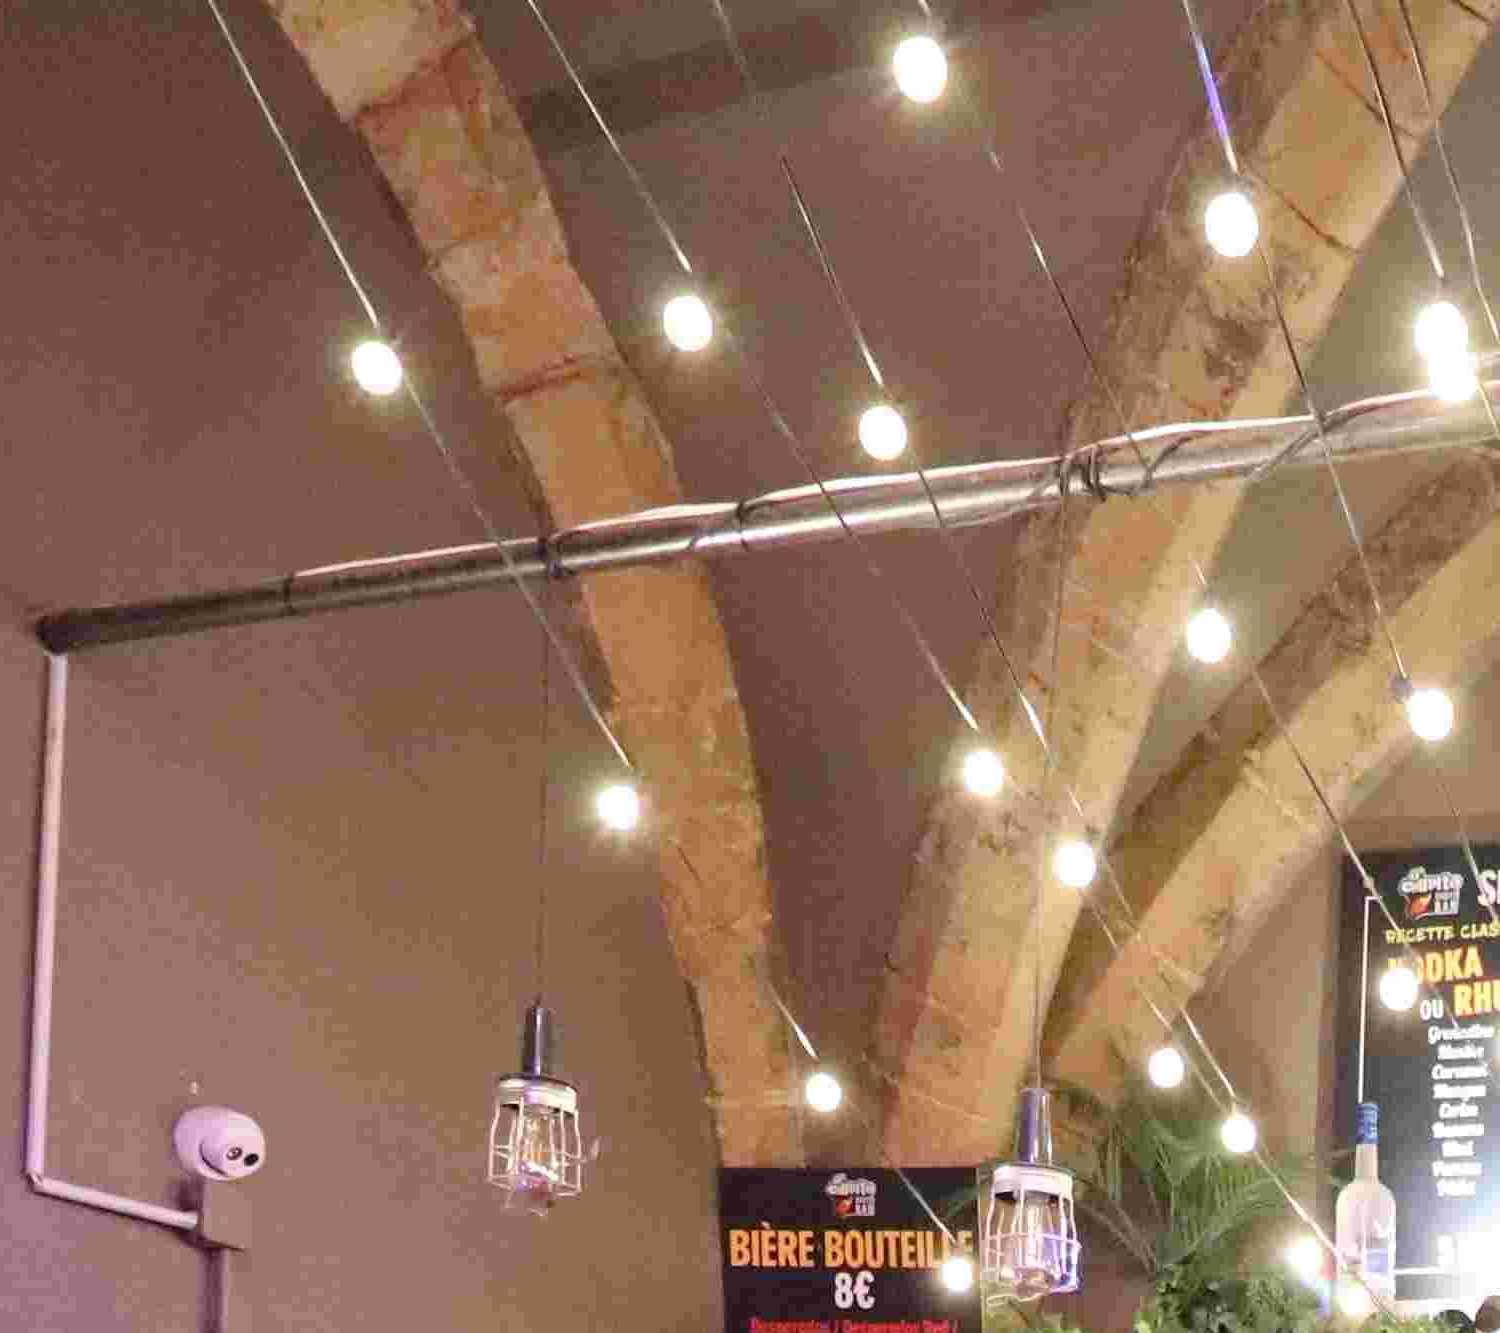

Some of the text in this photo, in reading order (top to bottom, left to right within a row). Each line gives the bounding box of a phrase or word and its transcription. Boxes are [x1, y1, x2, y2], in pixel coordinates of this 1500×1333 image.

[1385, 925, 1454, 945] RECETTE
[1387, 944, 1484, 984] ODKA
[1419, 997, 1445, 1021] OU
[728, 1221, 815, 1268] BIÈRE
[834, 1270, 875, 1310] 8€
